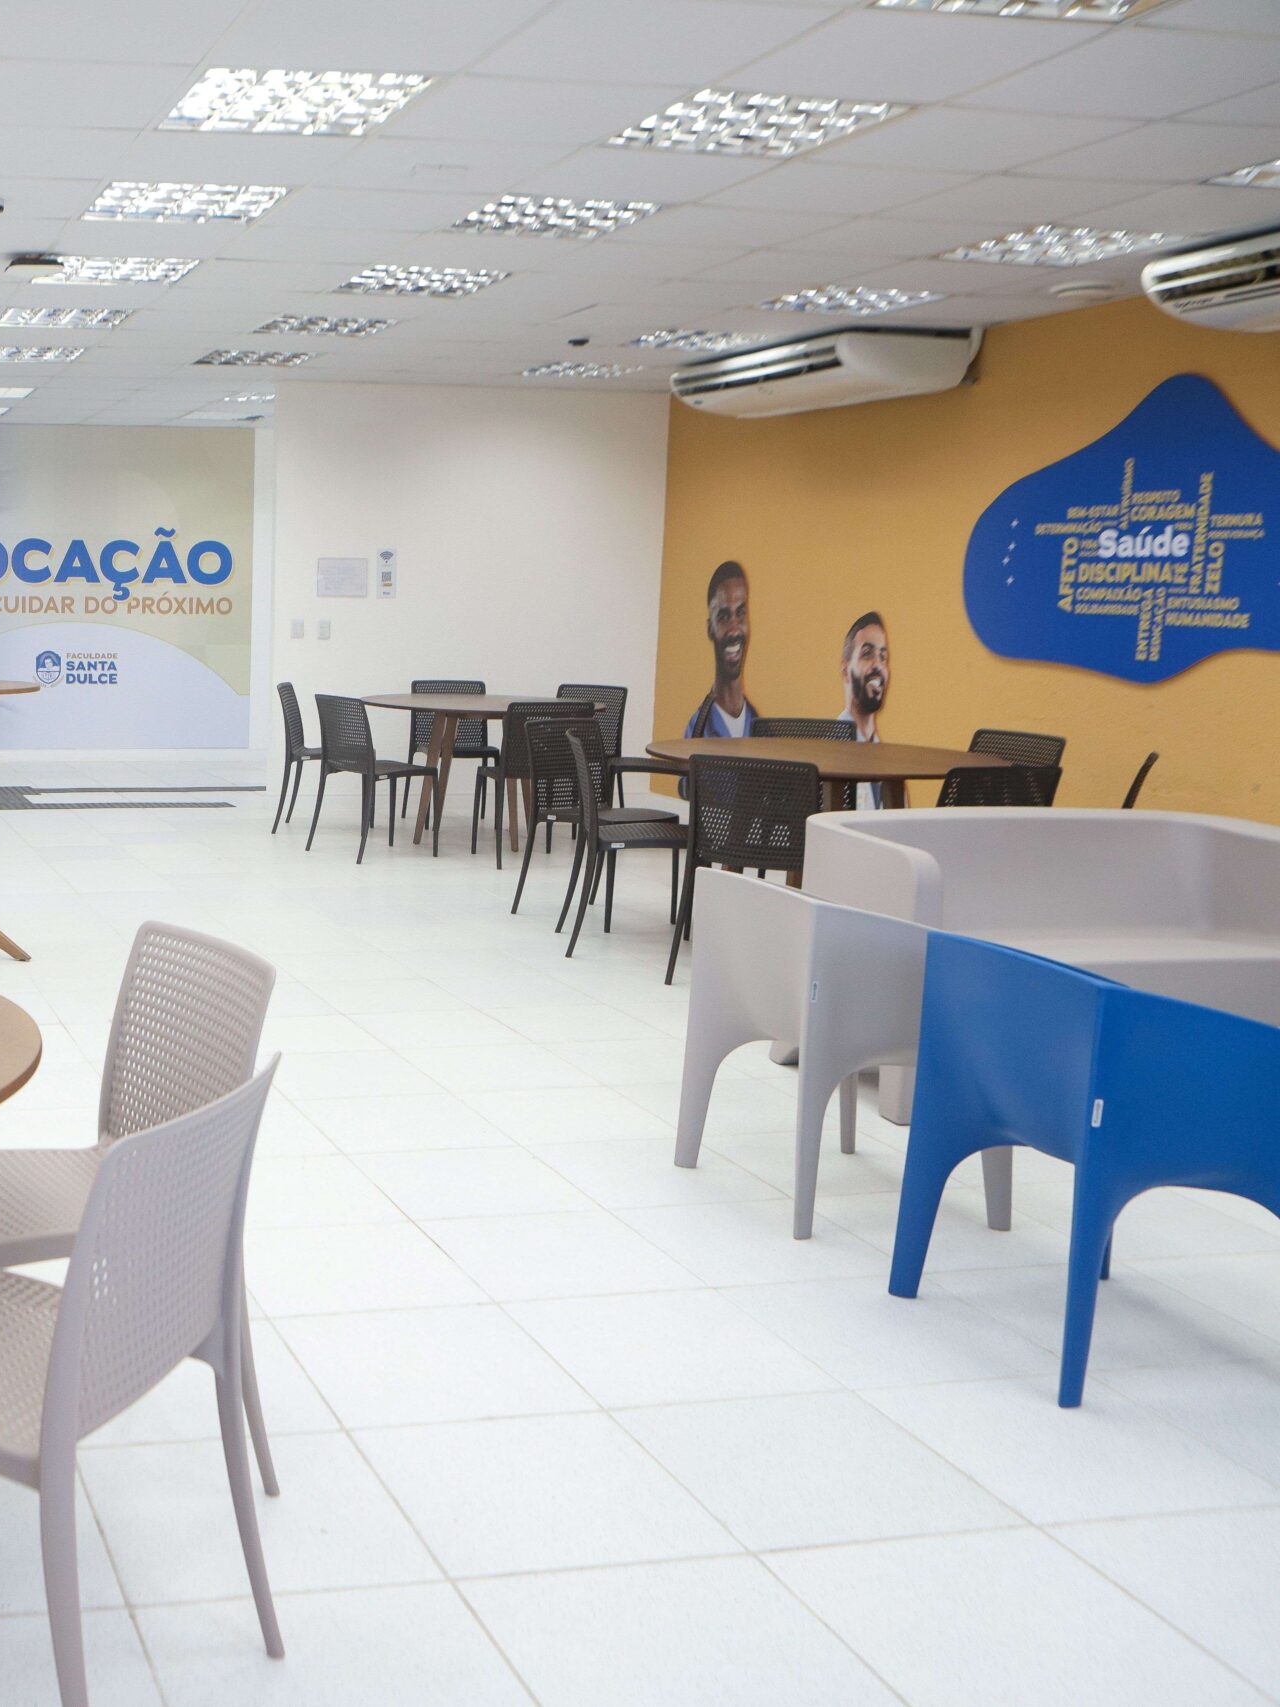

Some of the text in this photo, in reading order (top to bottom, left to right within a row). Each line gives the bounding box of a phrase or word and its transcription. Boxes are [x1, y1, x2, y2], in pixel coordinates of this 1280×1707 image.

[1130, 503, 1196, 521] CORAGEM
[1210, 512, 1263, 528] TERNURA
[1098, 526, 1190, 559] Saúde
[1188, 471, 1214, 594] FRATERNIDADE
[1058, 537, 1079, 612] AFETO
[1078, 562, 1172, 583] DISCIPLINA
[1204, 541, 1225, 594] ZELO
[84, 596, 119, 615] DO
[127, 593, 233, 616] PRÓXIMO
[1135, 588, 1154, 661] ENTREGA
[1165, 612, 1250, 629] HUMANIDADE
[66, 652, 118, 660] FACULDADE
[66, 660, 118, 672] SANTA
[65, 673, 118, 685] DULCE
